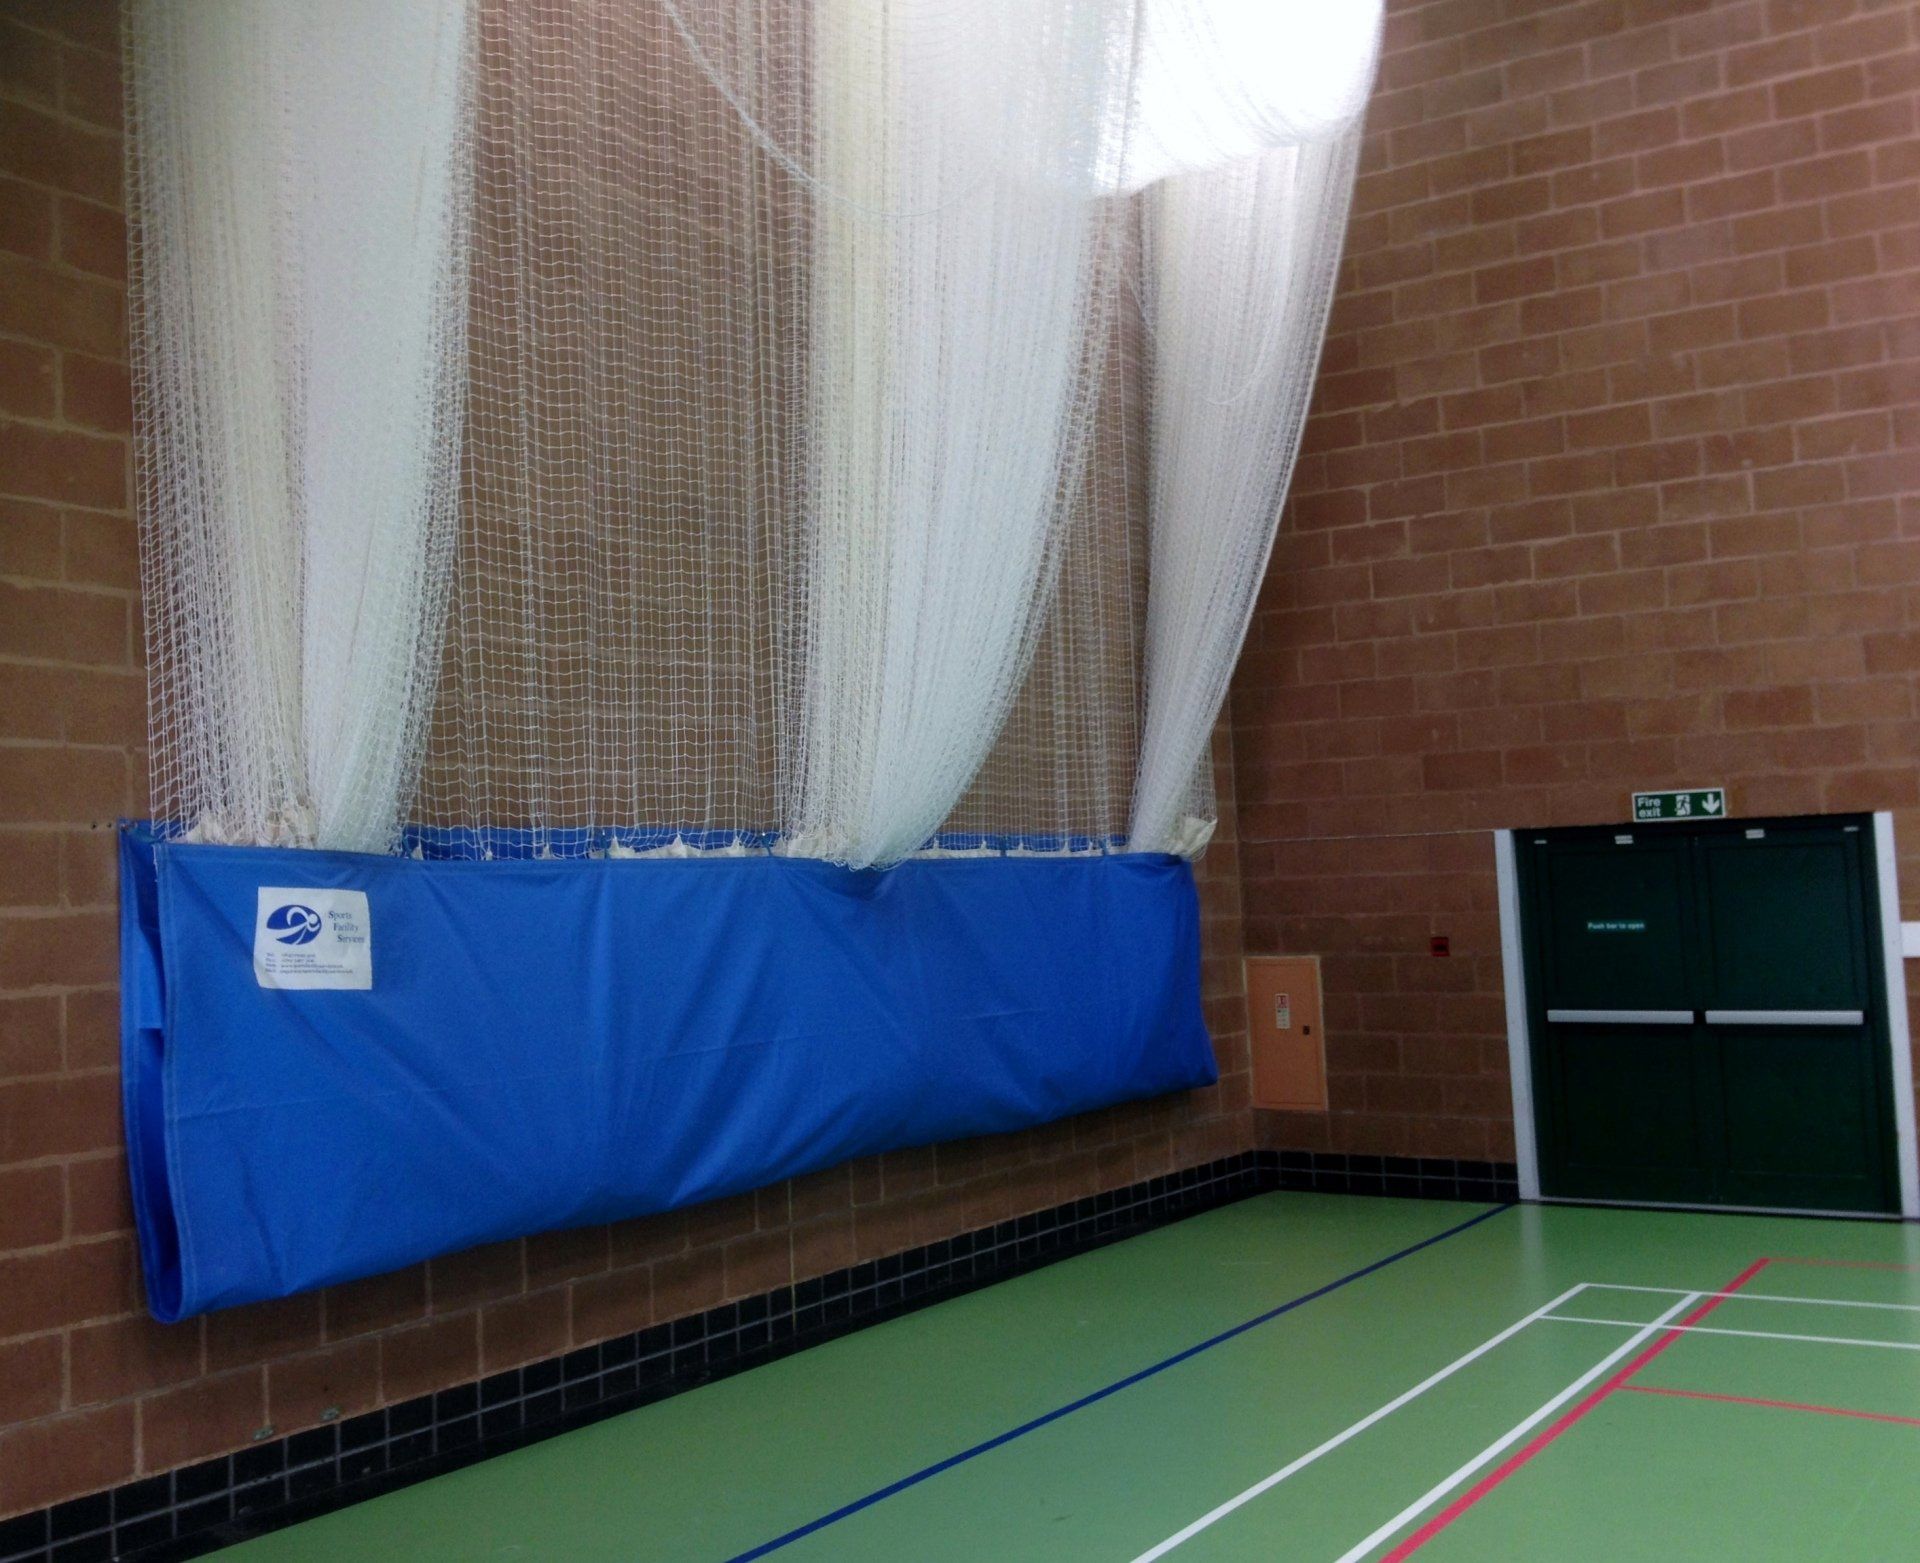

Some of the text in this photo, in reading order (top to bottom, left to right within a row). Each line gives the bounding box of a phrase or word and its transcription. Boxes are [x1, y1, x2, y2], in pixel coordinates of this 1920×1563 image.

[1637, 797, 1661, 807] Fire
[1638, 808, 1661, 817] exit
[328, 911, 352, 921] Sports
[333, 922, 359, 932] Facility
[1587, 922, 1605, 930] Push
[1606, 922, 1617, 930] bar
[1627, 923, 1645, 931] open
[337, 935, 365, 943] Services
